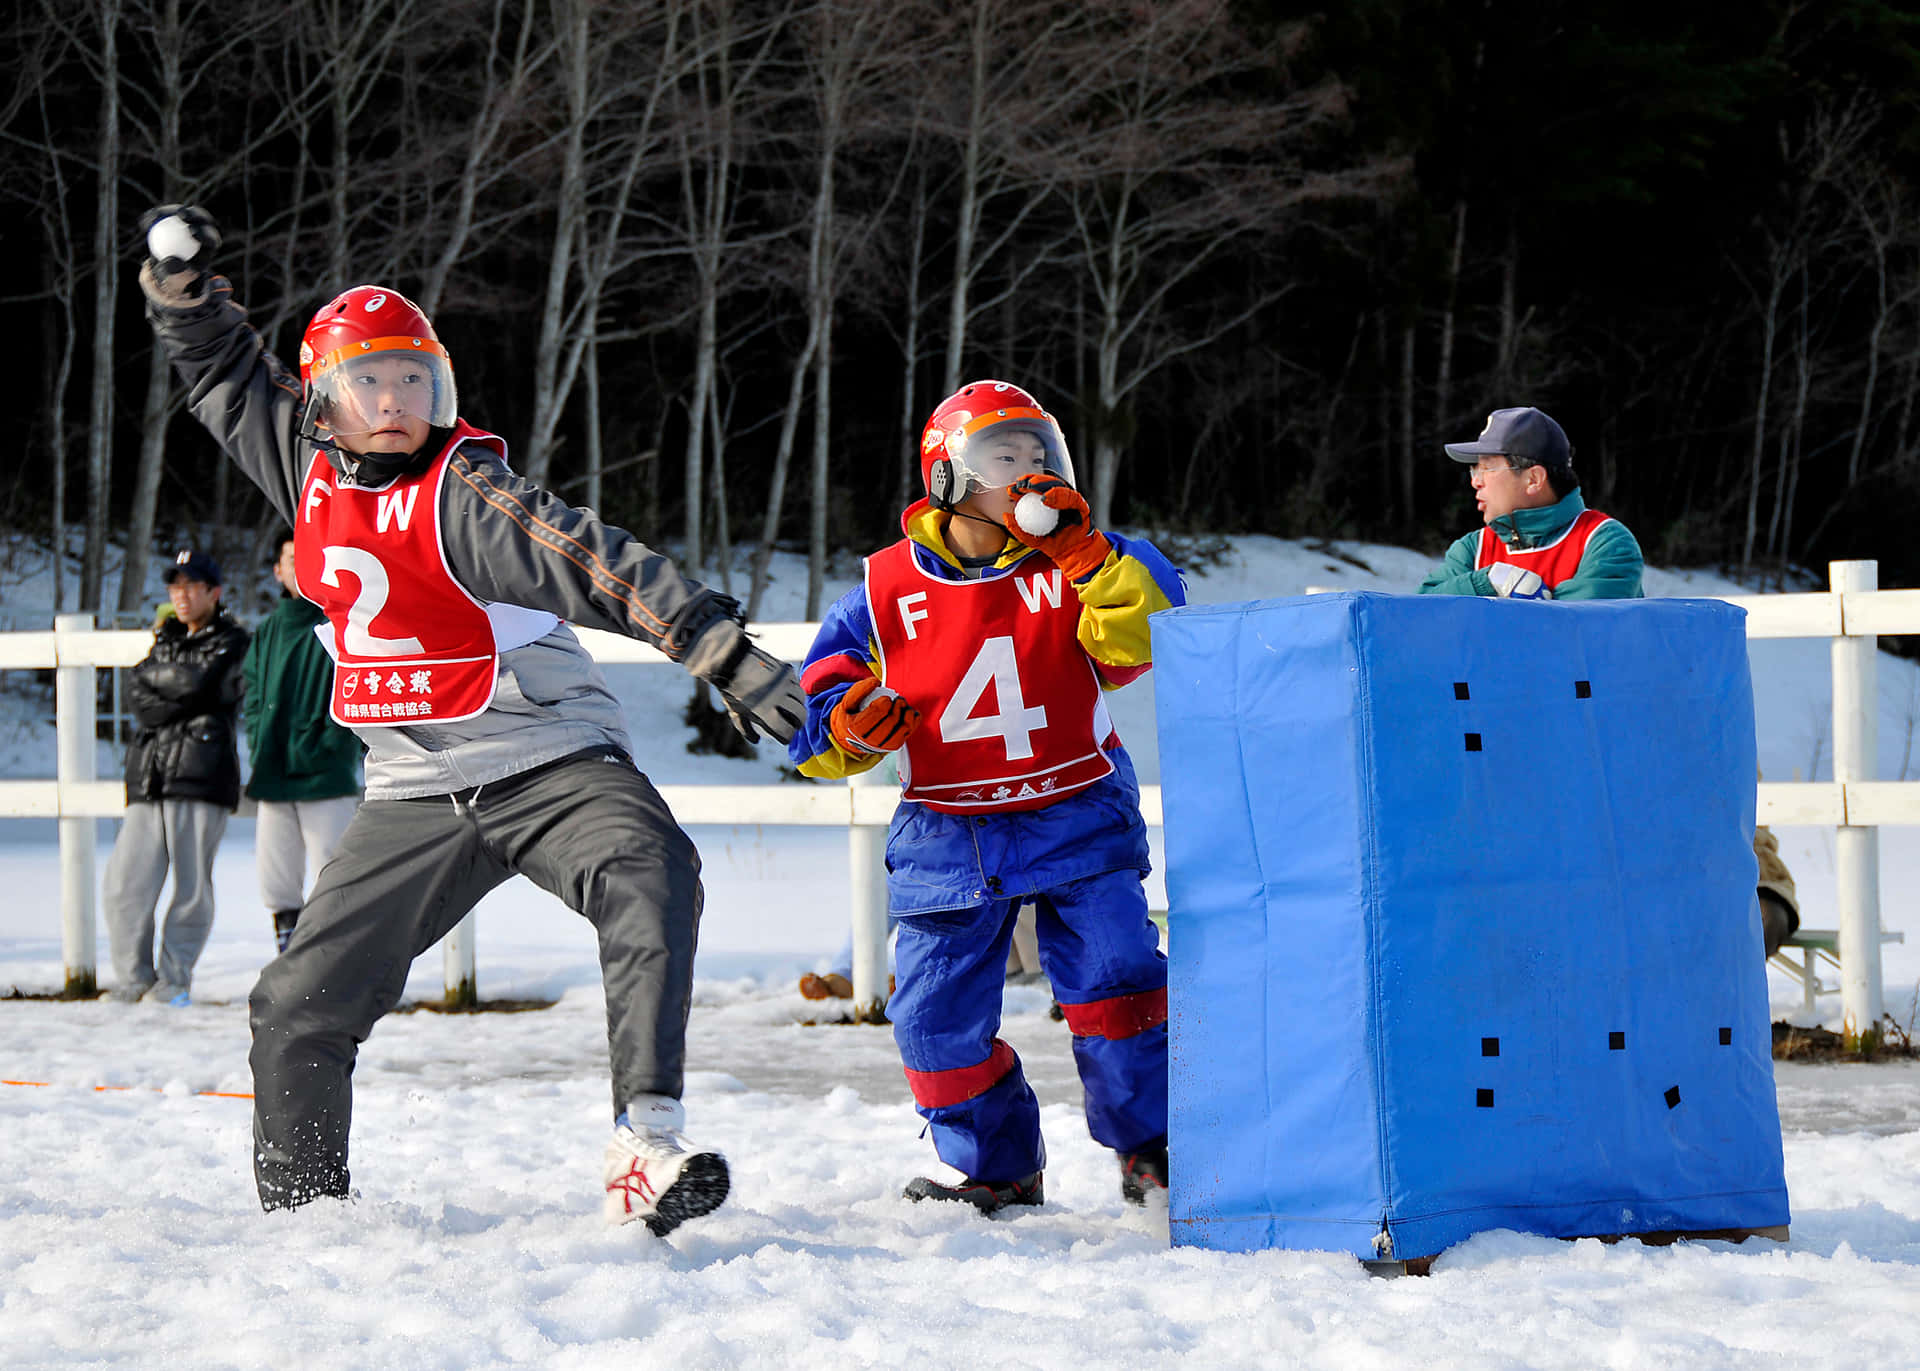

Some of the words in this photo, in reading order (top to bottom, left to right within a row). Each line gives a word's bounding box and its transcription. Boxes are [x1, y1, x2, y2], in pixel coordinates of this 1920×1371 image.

[304, 478, 332, 523] F
[376, 485, 420, 534] W
[320, 545, 426, 658] 2
[897, 591, 929, 641] F
[1014, 569, 1063, 614] W
[938, 635, 1048, 761] 4
